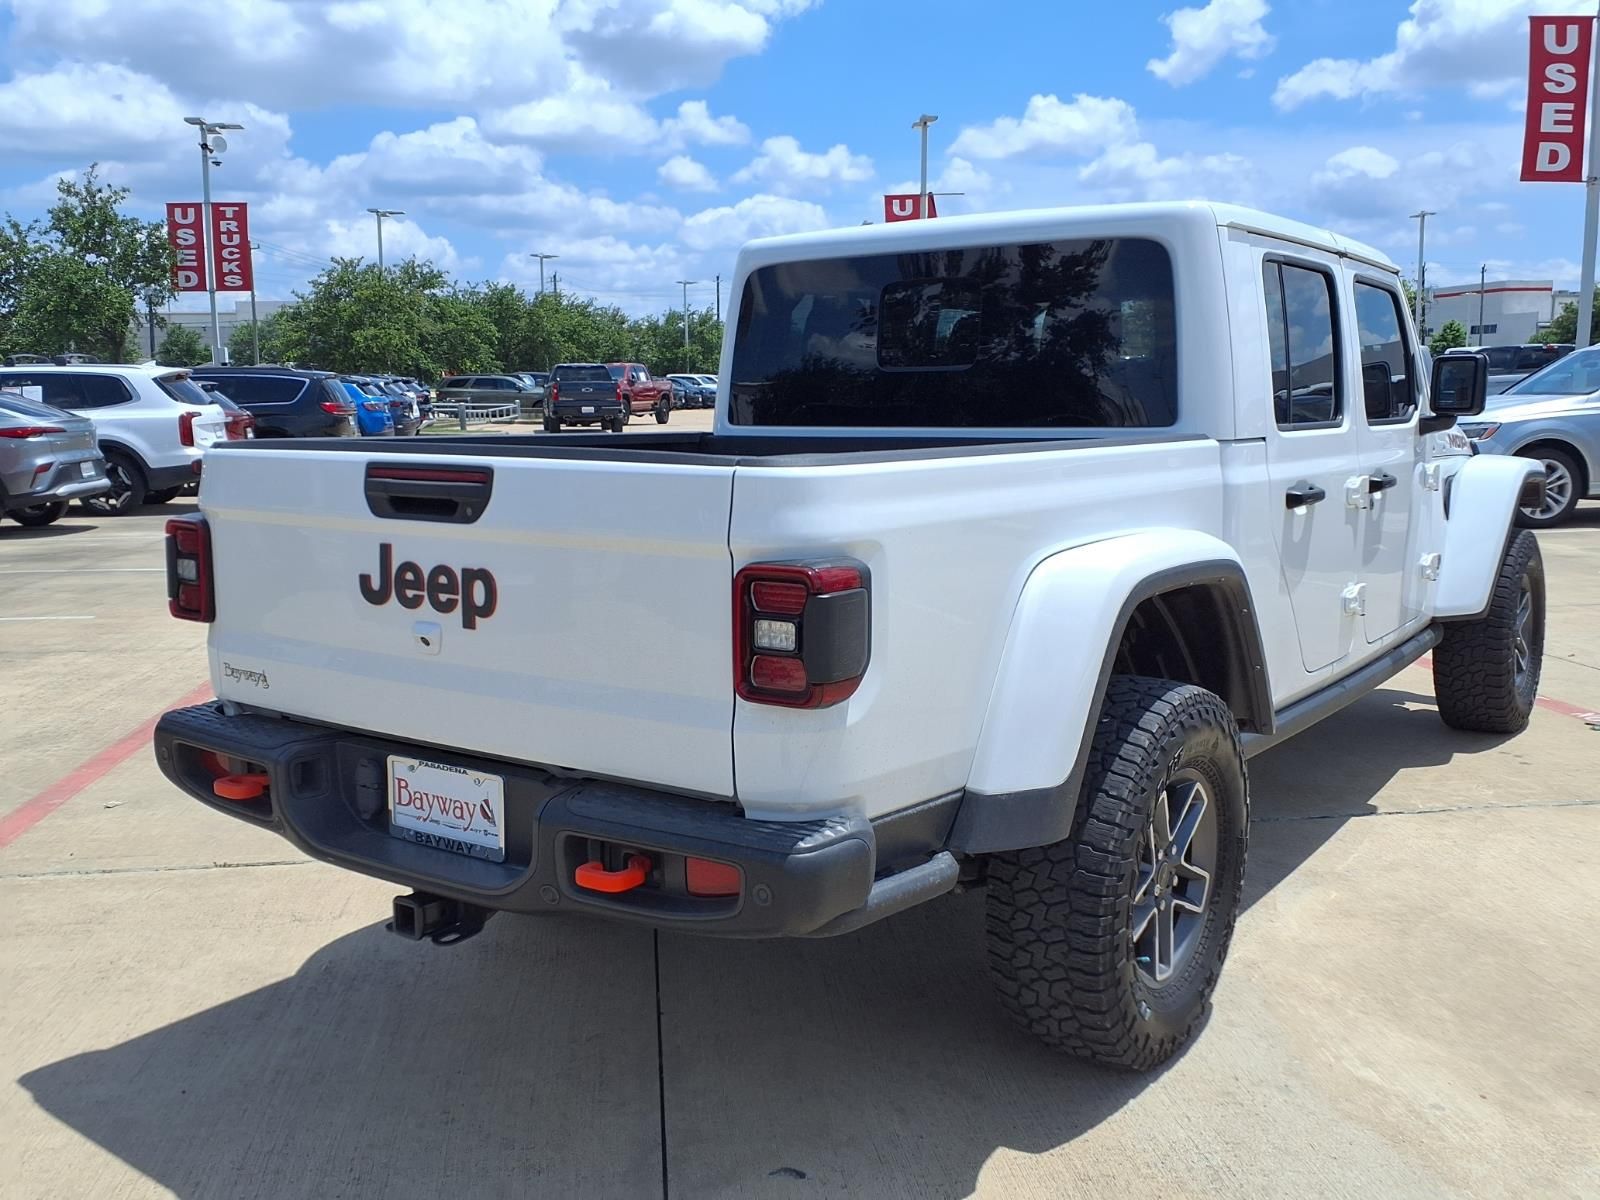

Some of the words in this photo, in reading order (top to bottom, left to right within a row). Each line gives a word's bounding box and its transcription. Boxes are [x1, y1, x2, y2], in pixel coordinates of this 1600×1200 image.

[1535, 24, 1579, 172] USED
[174, 207, 199, 288] USED
[219, 206, 243, 287] TRUCKS
[359, 542, 497, 630] Jeep
[395, 777, 477, 832] Bayway
[418, 760, 469, 776] PASADENA
[415, 831, 474, 855] BAYWAY
